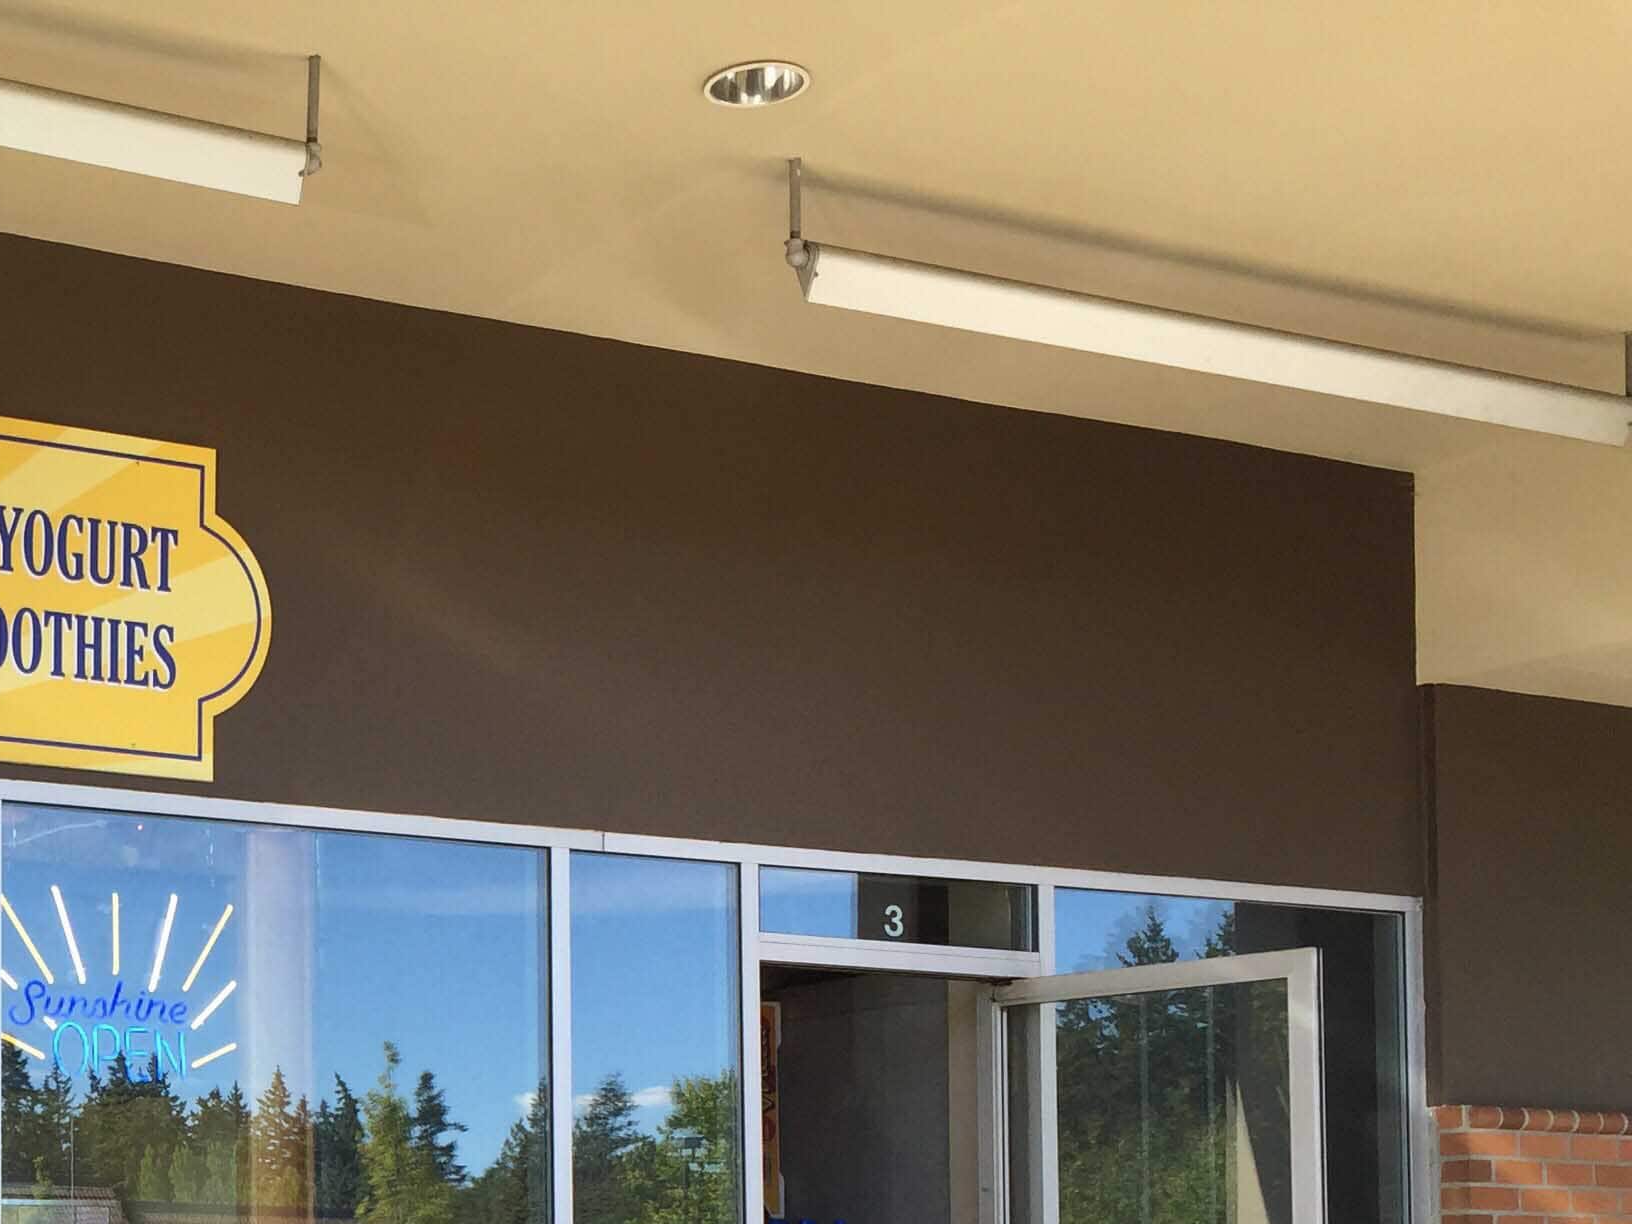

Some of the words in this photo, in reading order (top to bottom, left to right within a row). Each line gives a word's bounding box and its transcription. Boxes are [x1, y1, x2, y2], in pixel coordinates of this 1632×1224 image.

[884, 905, 904, 937] 3
[9, 979, 188, 1026] Sunshine
[53, 1021, 187, 1083] OPEN
